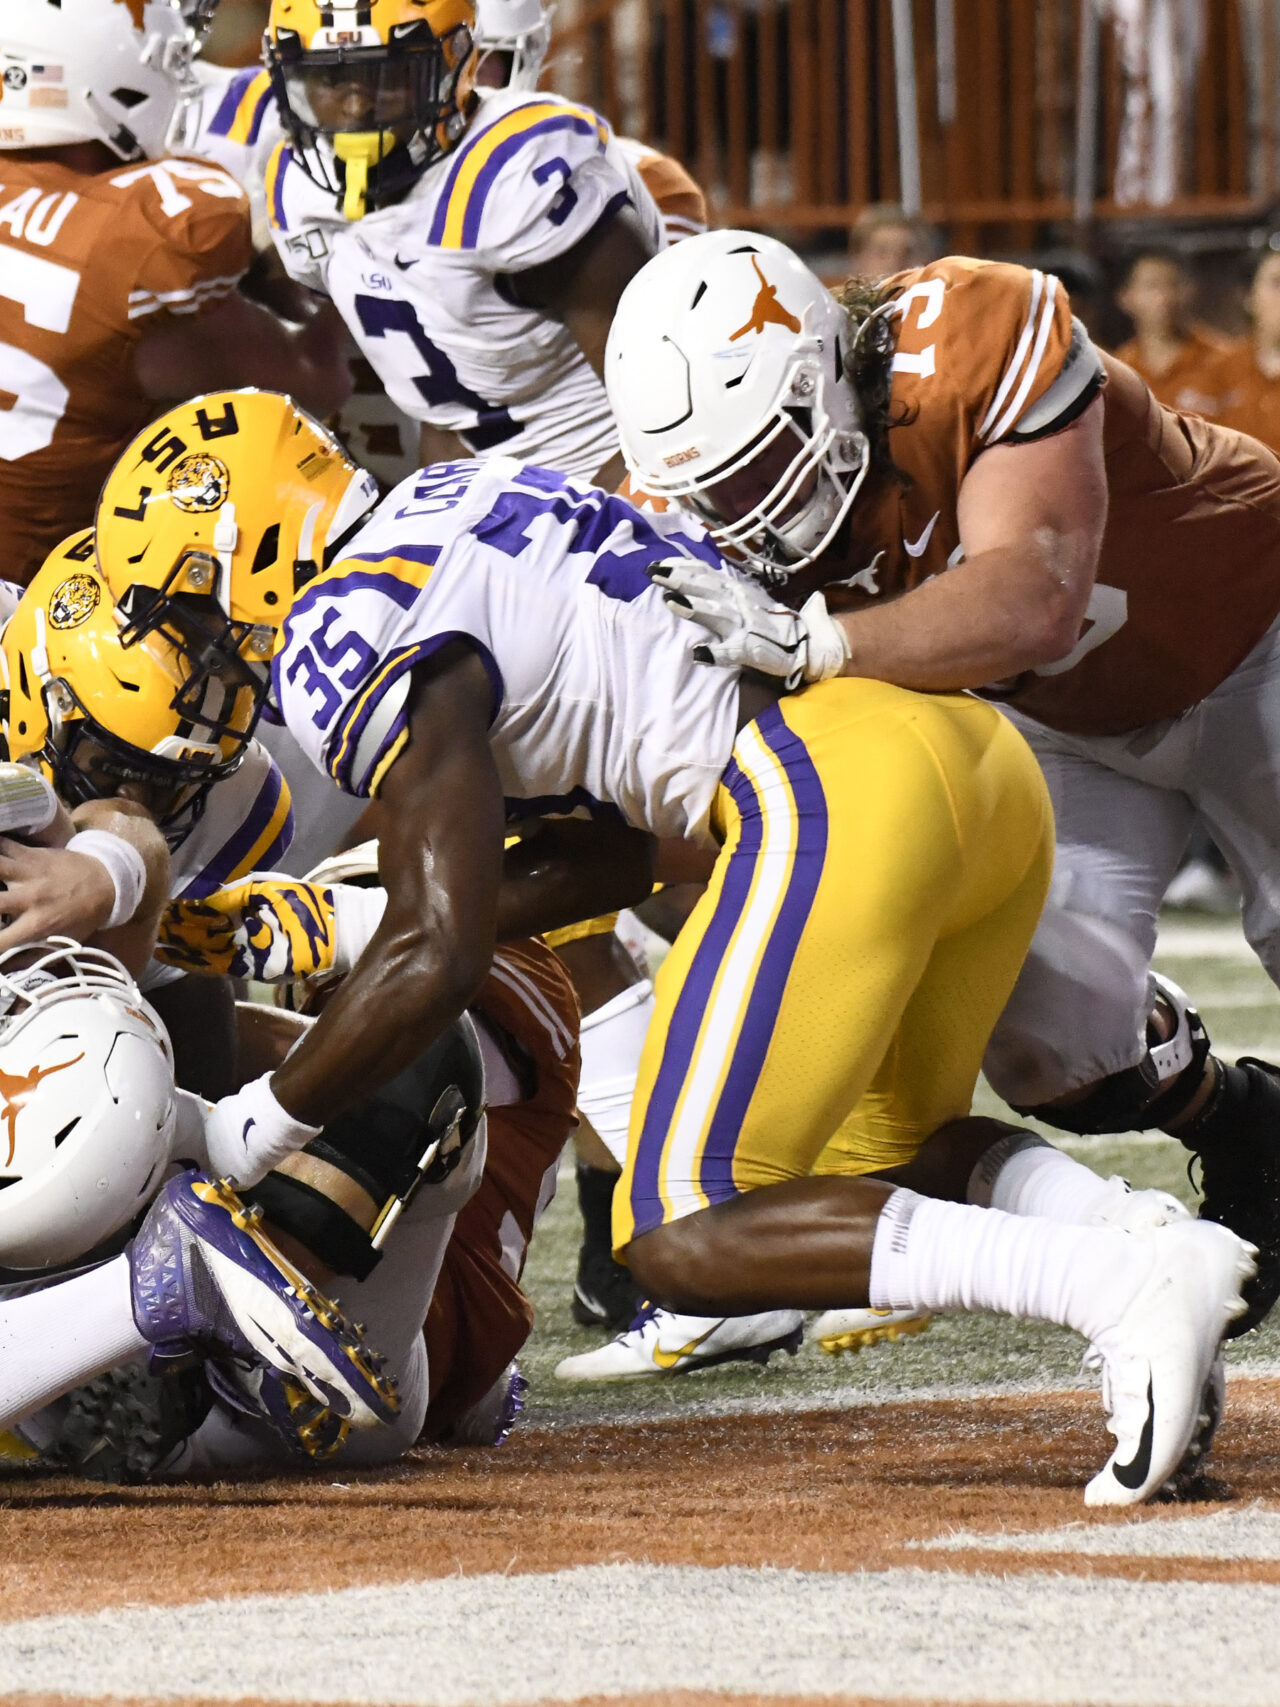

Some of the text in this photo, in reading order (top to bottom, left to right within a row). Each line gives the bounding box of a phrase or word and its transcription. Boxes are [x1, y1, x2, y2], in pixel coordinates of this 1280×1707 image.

[326, 31, 362, 46] LSU
[532, 156, 579, 226] 3
[361, 273, 392, 291] LSU
[114, 402, 240, 523] LSU
[286, 606, 380, 731] 35
